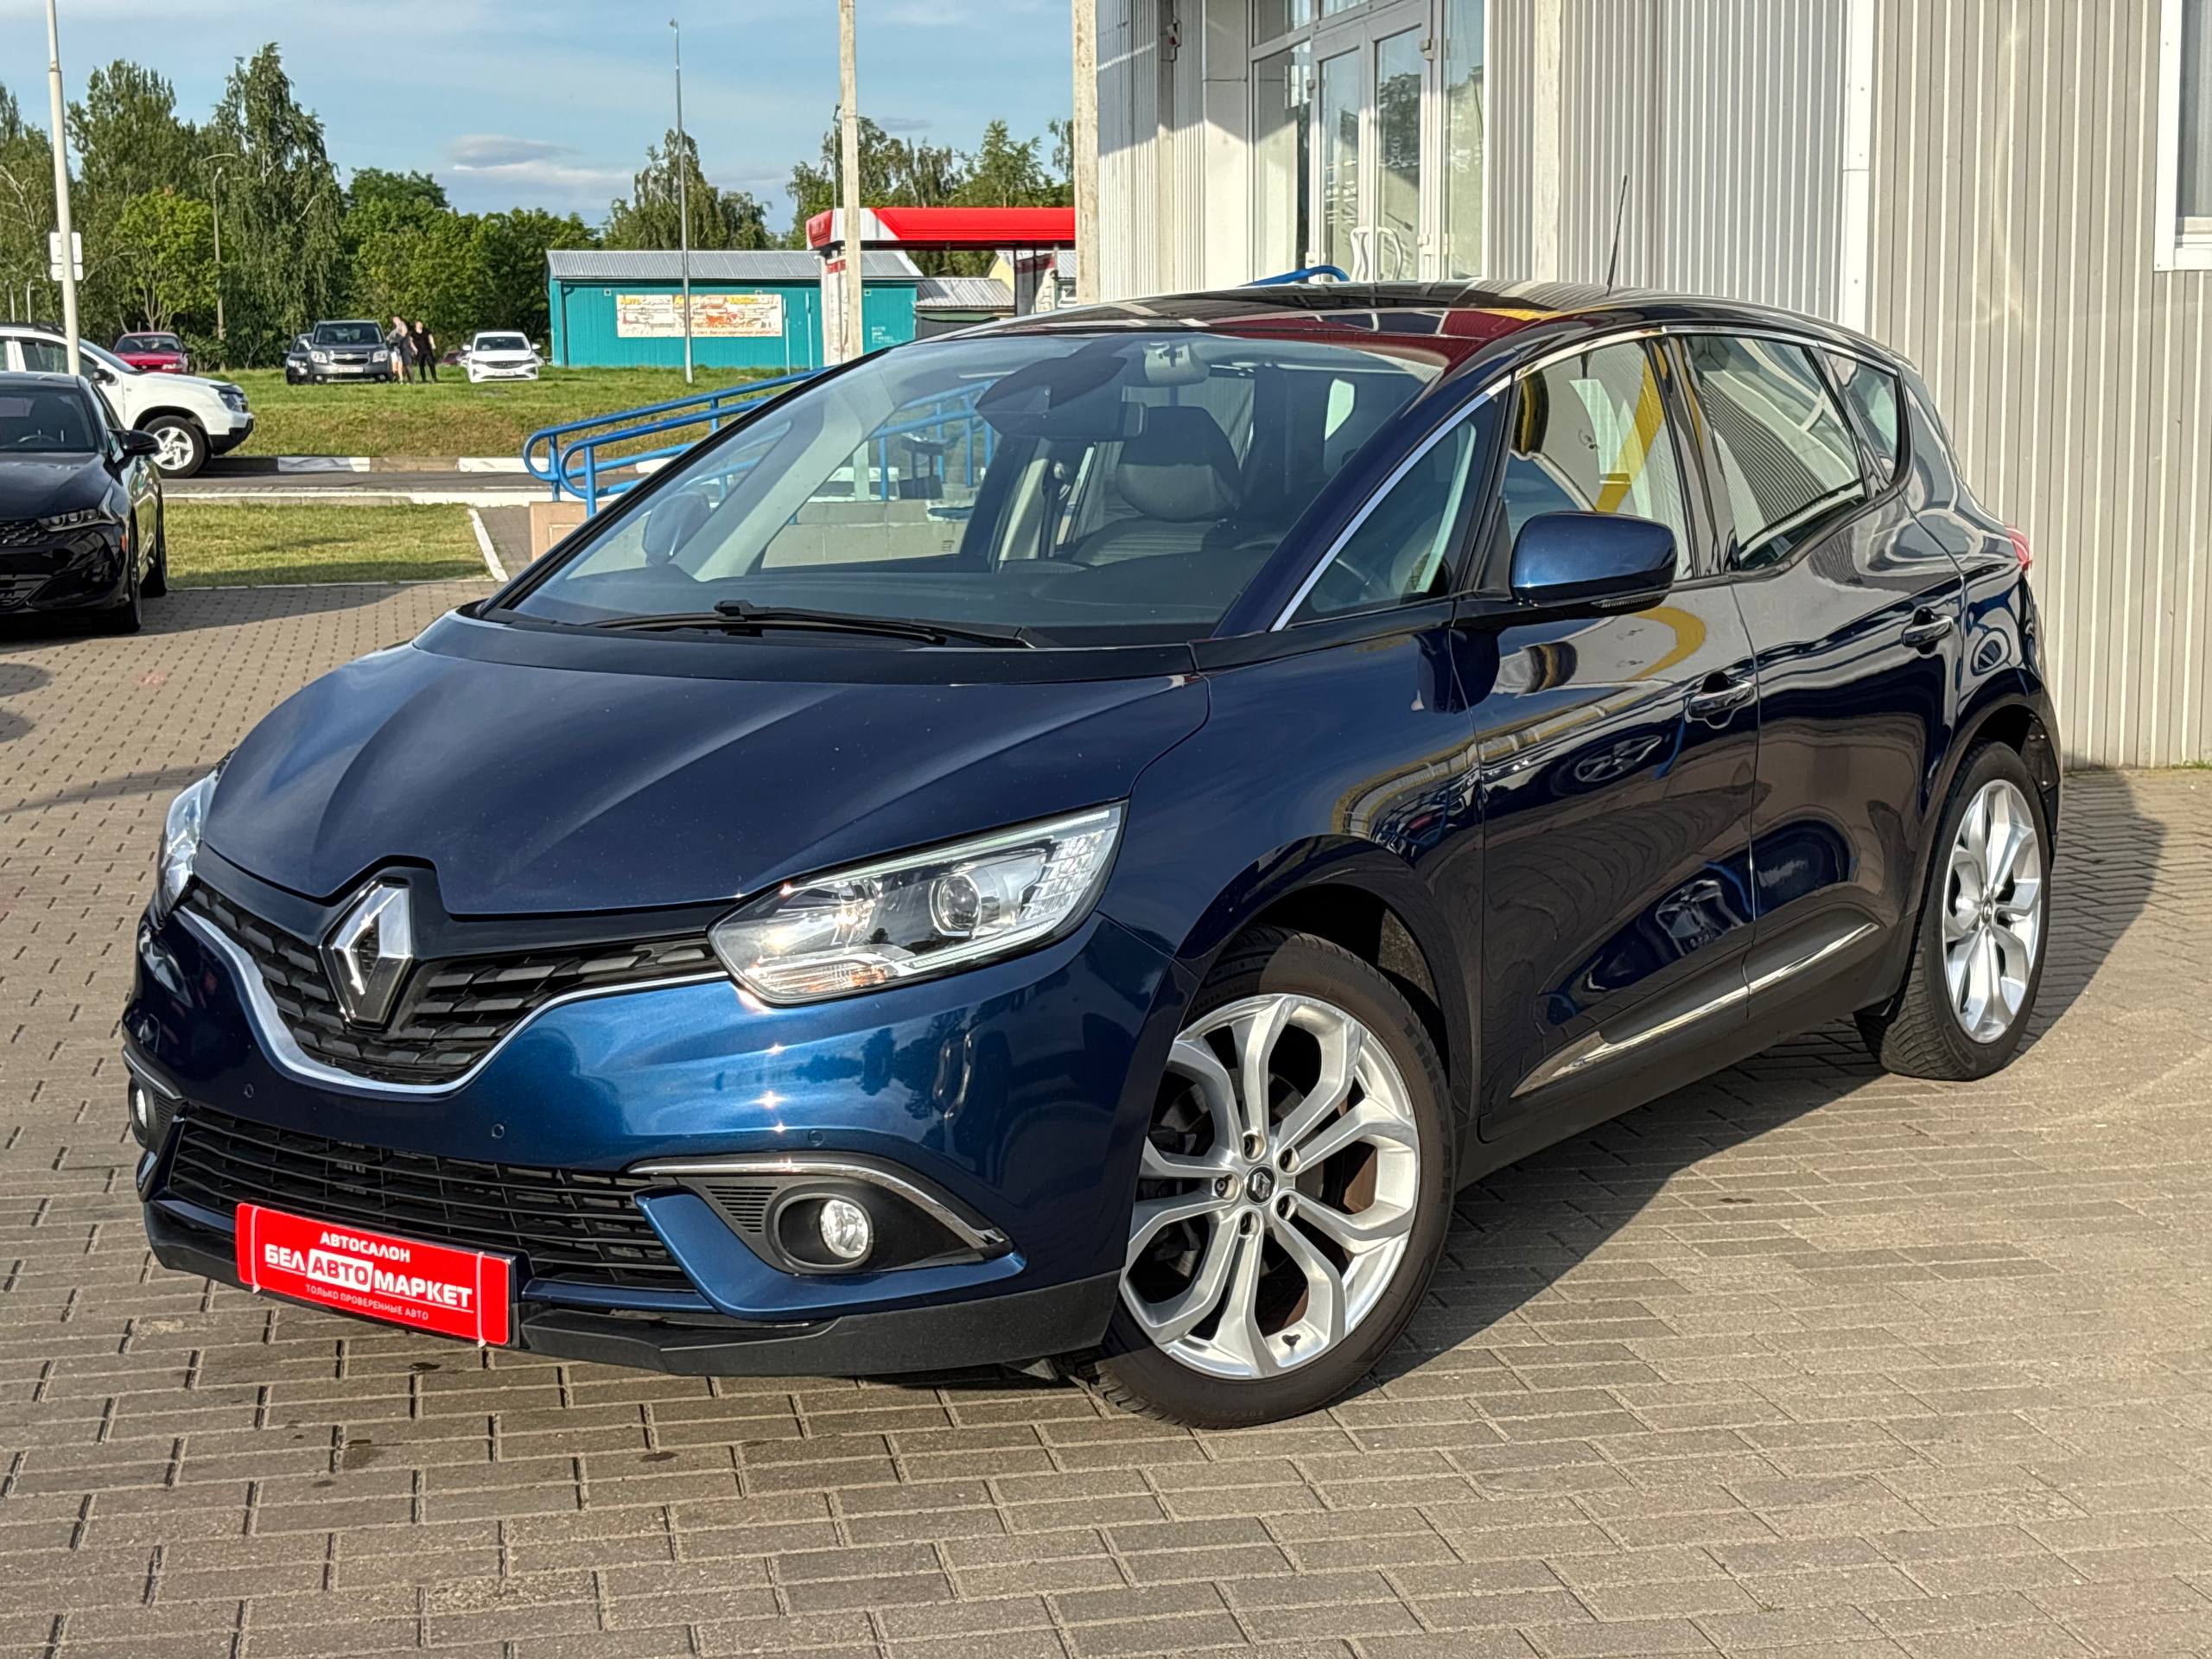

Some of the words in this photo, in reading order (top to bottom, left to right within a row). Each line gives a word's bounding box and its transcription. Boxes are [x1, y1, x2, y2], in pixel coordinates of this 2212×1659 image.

[320, 1231, 410, 1262] АВТОСАЛОН
[305, 1283, 339, 1300] ТОЛЬКО
[340, 1290, 404, 1315] ПРОВЕРЕННЫЕ
[404, 1307, 429, 1320] АВТО
